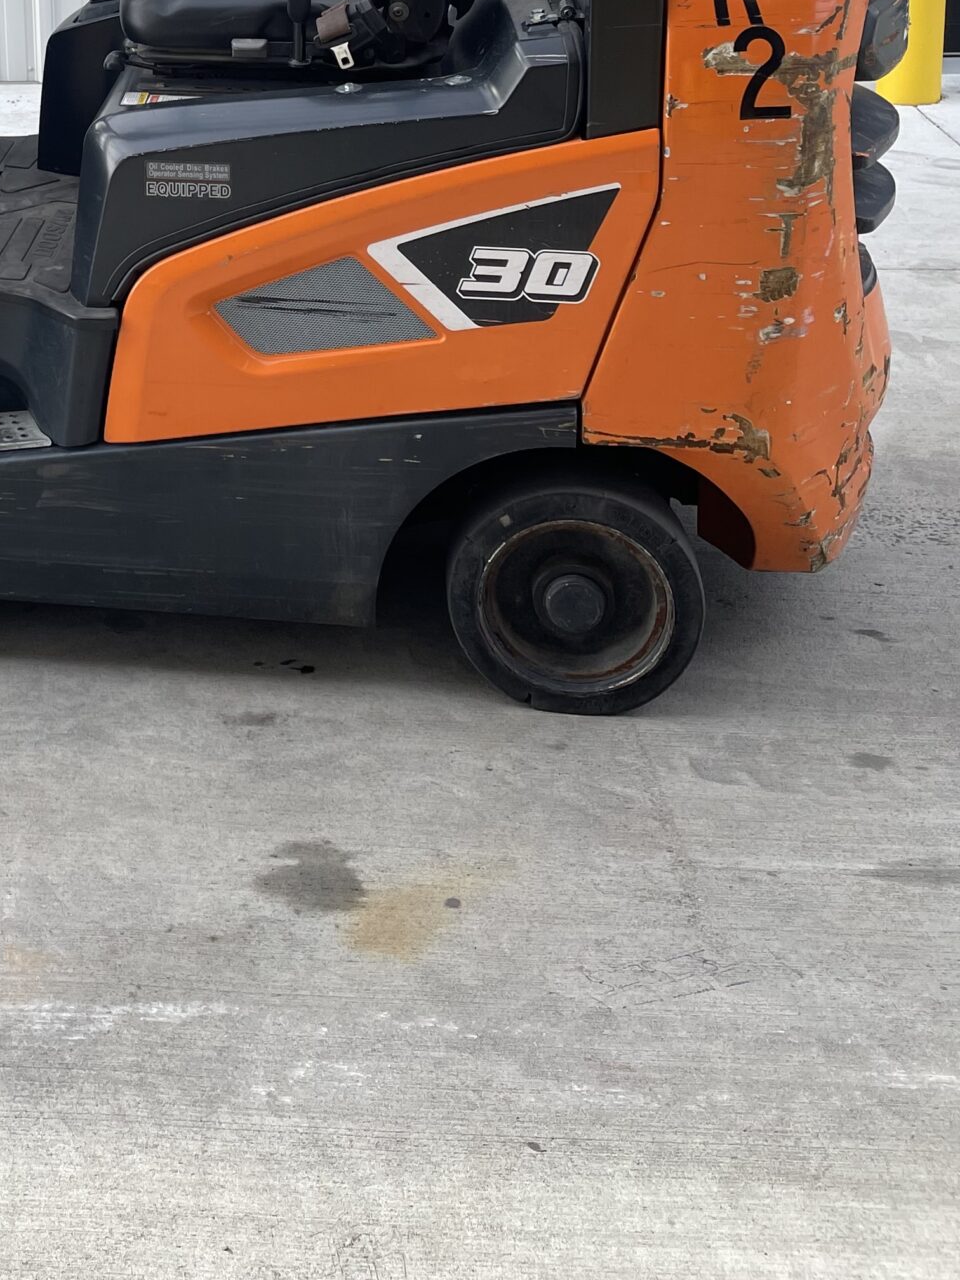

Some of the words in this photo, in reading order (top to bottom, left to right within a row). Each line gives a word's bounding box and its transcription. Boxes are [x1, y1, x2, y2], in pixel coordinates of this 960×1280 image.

[733, 26, 792, 121] 2
[148, 162, 158, 171] Oil
[160, 162, 184, 171] Cooled
[186, 163, 202, 172] Disc
[204, 164, 229, 173] Brakes
[148, 170, 176, 178] Operator
[177, 170, 203, 180] Sensing
[205, 171, 229, 180] System
[146, 181, 232, 198] EQUIPPED
[456, 246, 601, 304] 30
